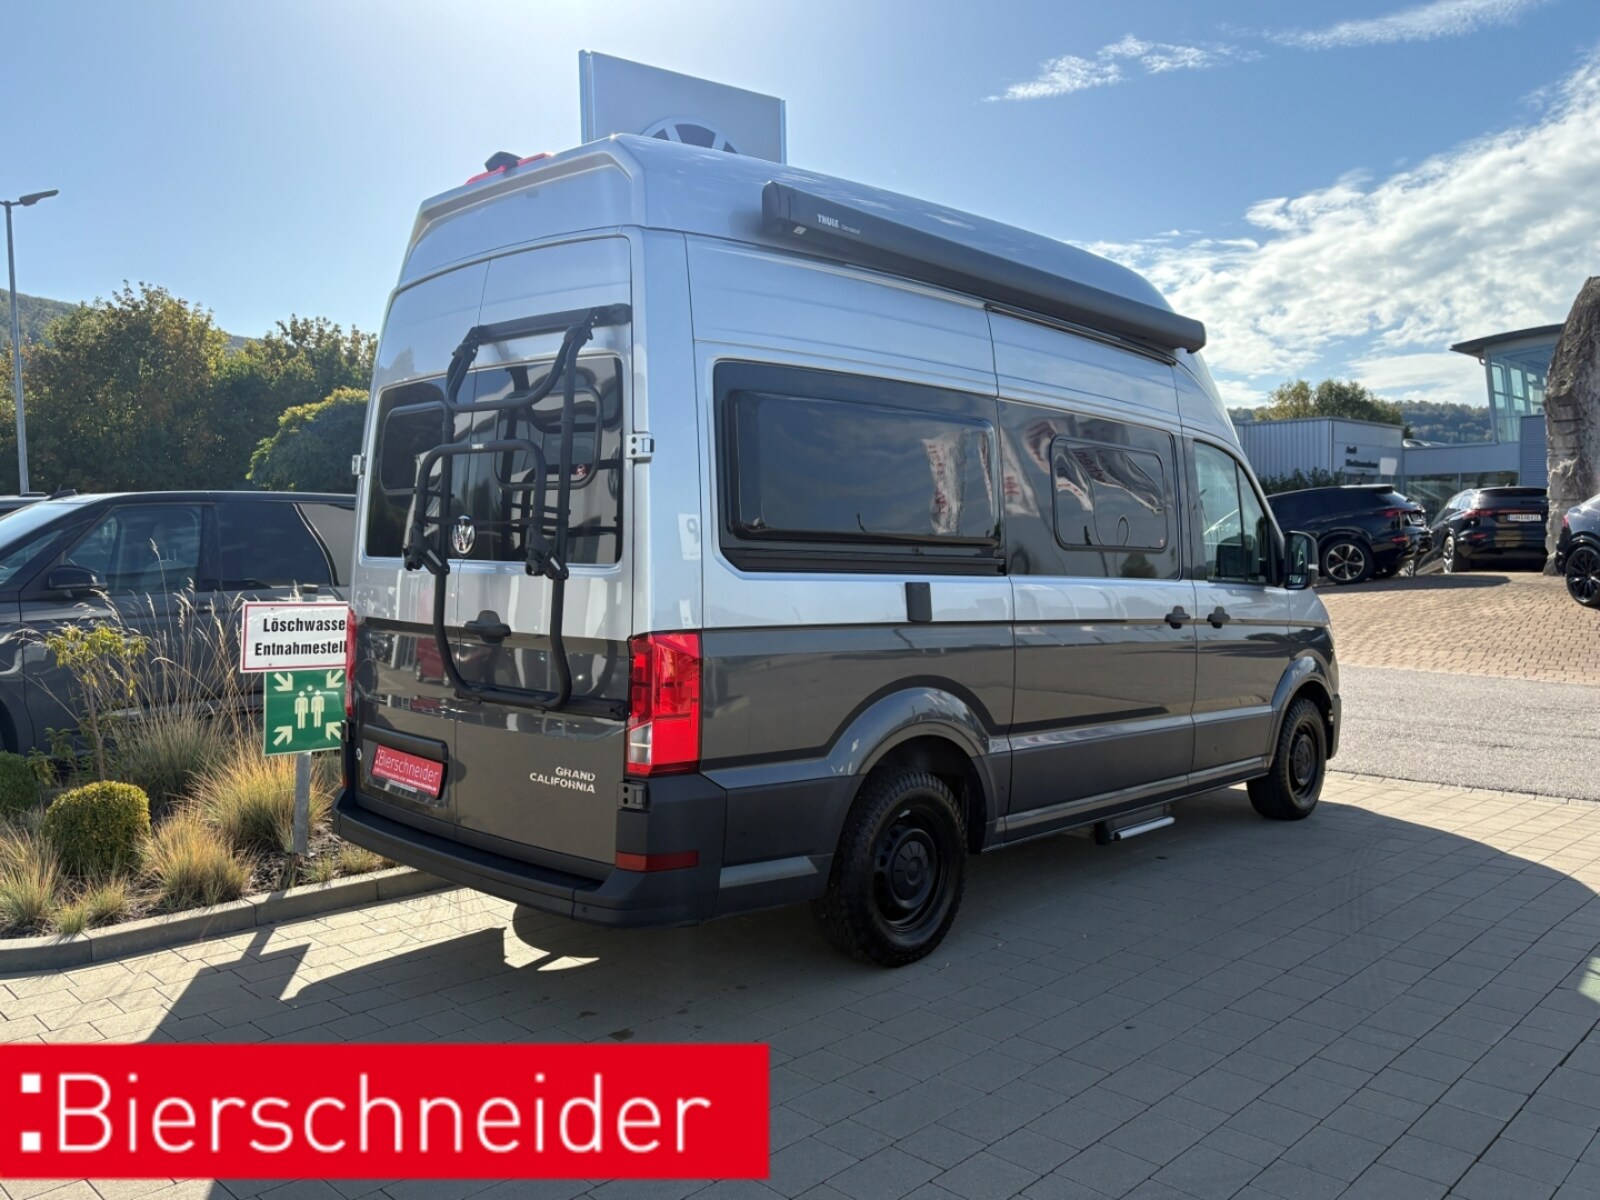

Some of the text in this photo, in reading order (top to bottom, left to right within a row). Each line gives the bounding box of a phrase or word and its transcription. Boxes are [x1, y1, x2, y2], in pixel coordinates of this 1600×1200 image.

[817, 214, 839, 228] THULE
[263, 618, 346, 632] Löschwasse
[254, 640, 347, 656] Entnahmestell
[555, 766, 596, 782] GRAND
[529, 772, 596, 794] CALIFORNIA
